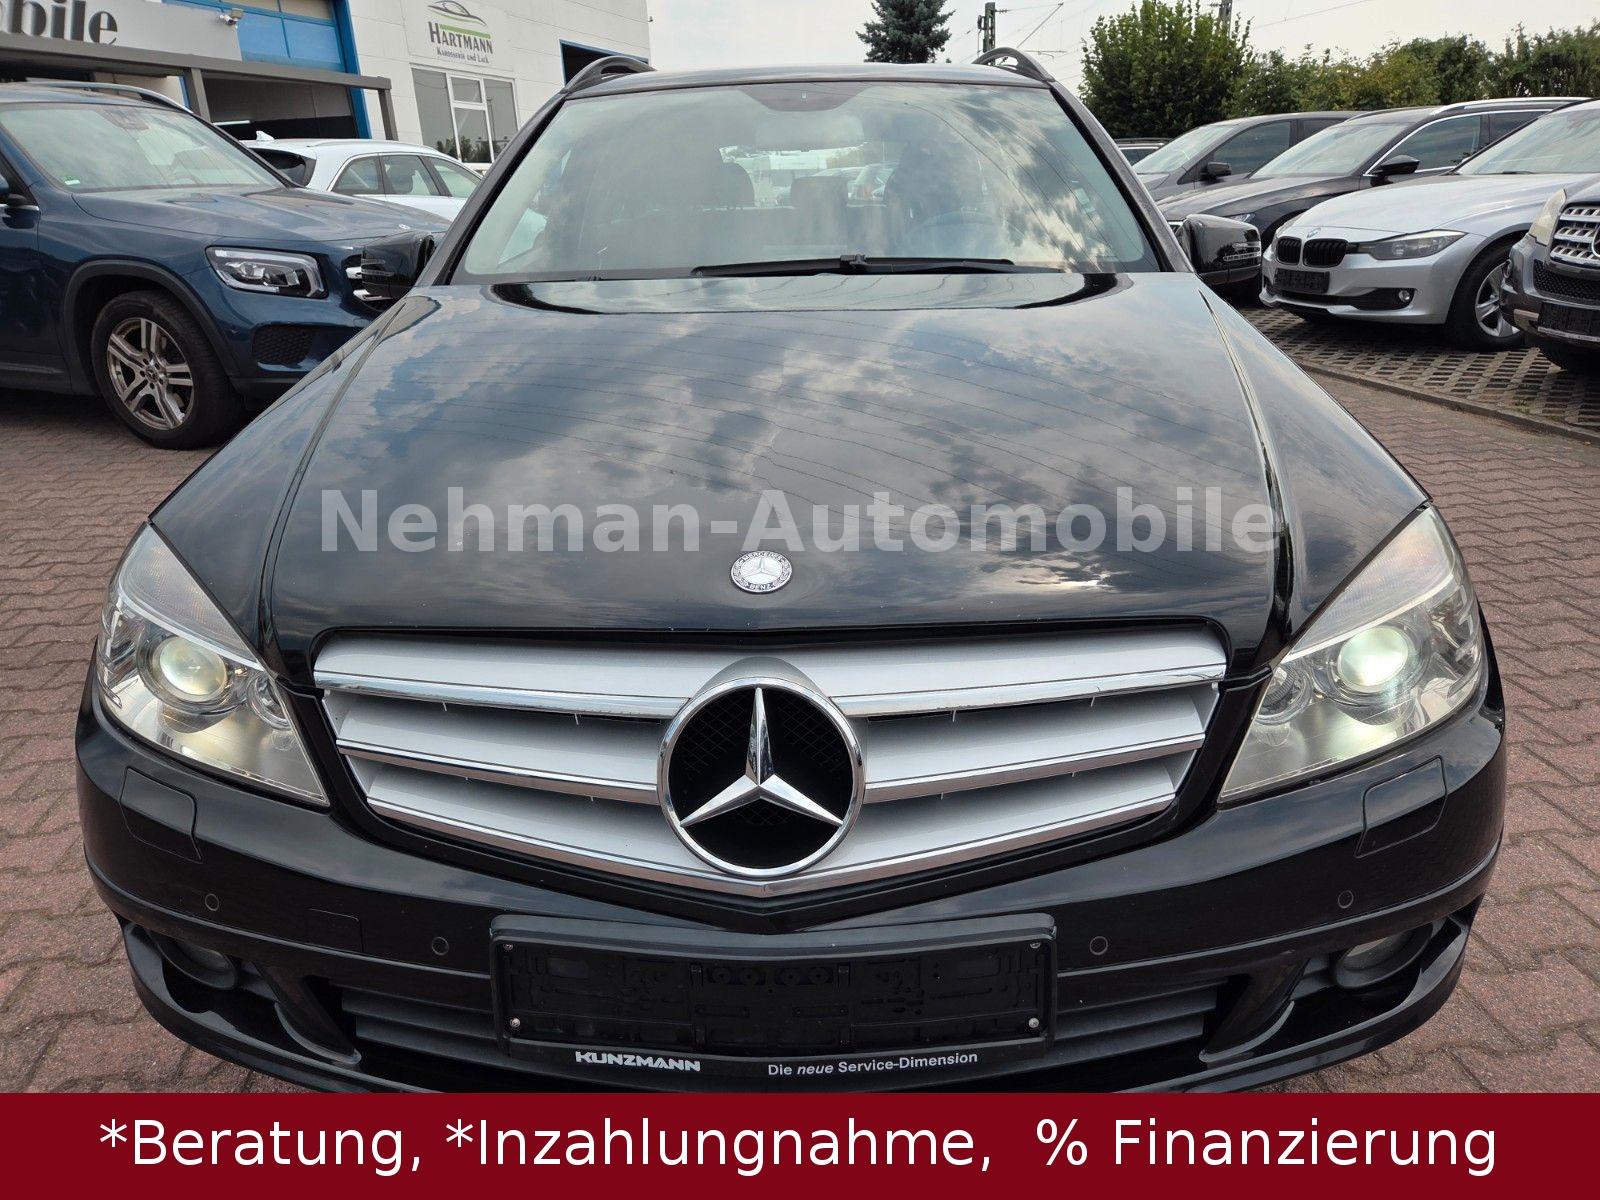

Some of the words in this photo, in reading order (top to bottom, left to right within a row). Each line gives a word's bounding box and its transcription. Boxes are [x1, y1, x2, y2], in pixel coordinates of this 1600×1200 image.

[0, 0, 118, 45] bile
[428, 21, 494, 54] HARTMANN
[467, 52, 476, 62] und
[749, 582, 773, 591] BENZ
[575, 1051, 700, 1072] KUNZMANN
[768, 1063, 793, 1076] Die
[796, 1062, 834, 1076] neue
[837, 1052, 979, 1073] Service-Dimension
